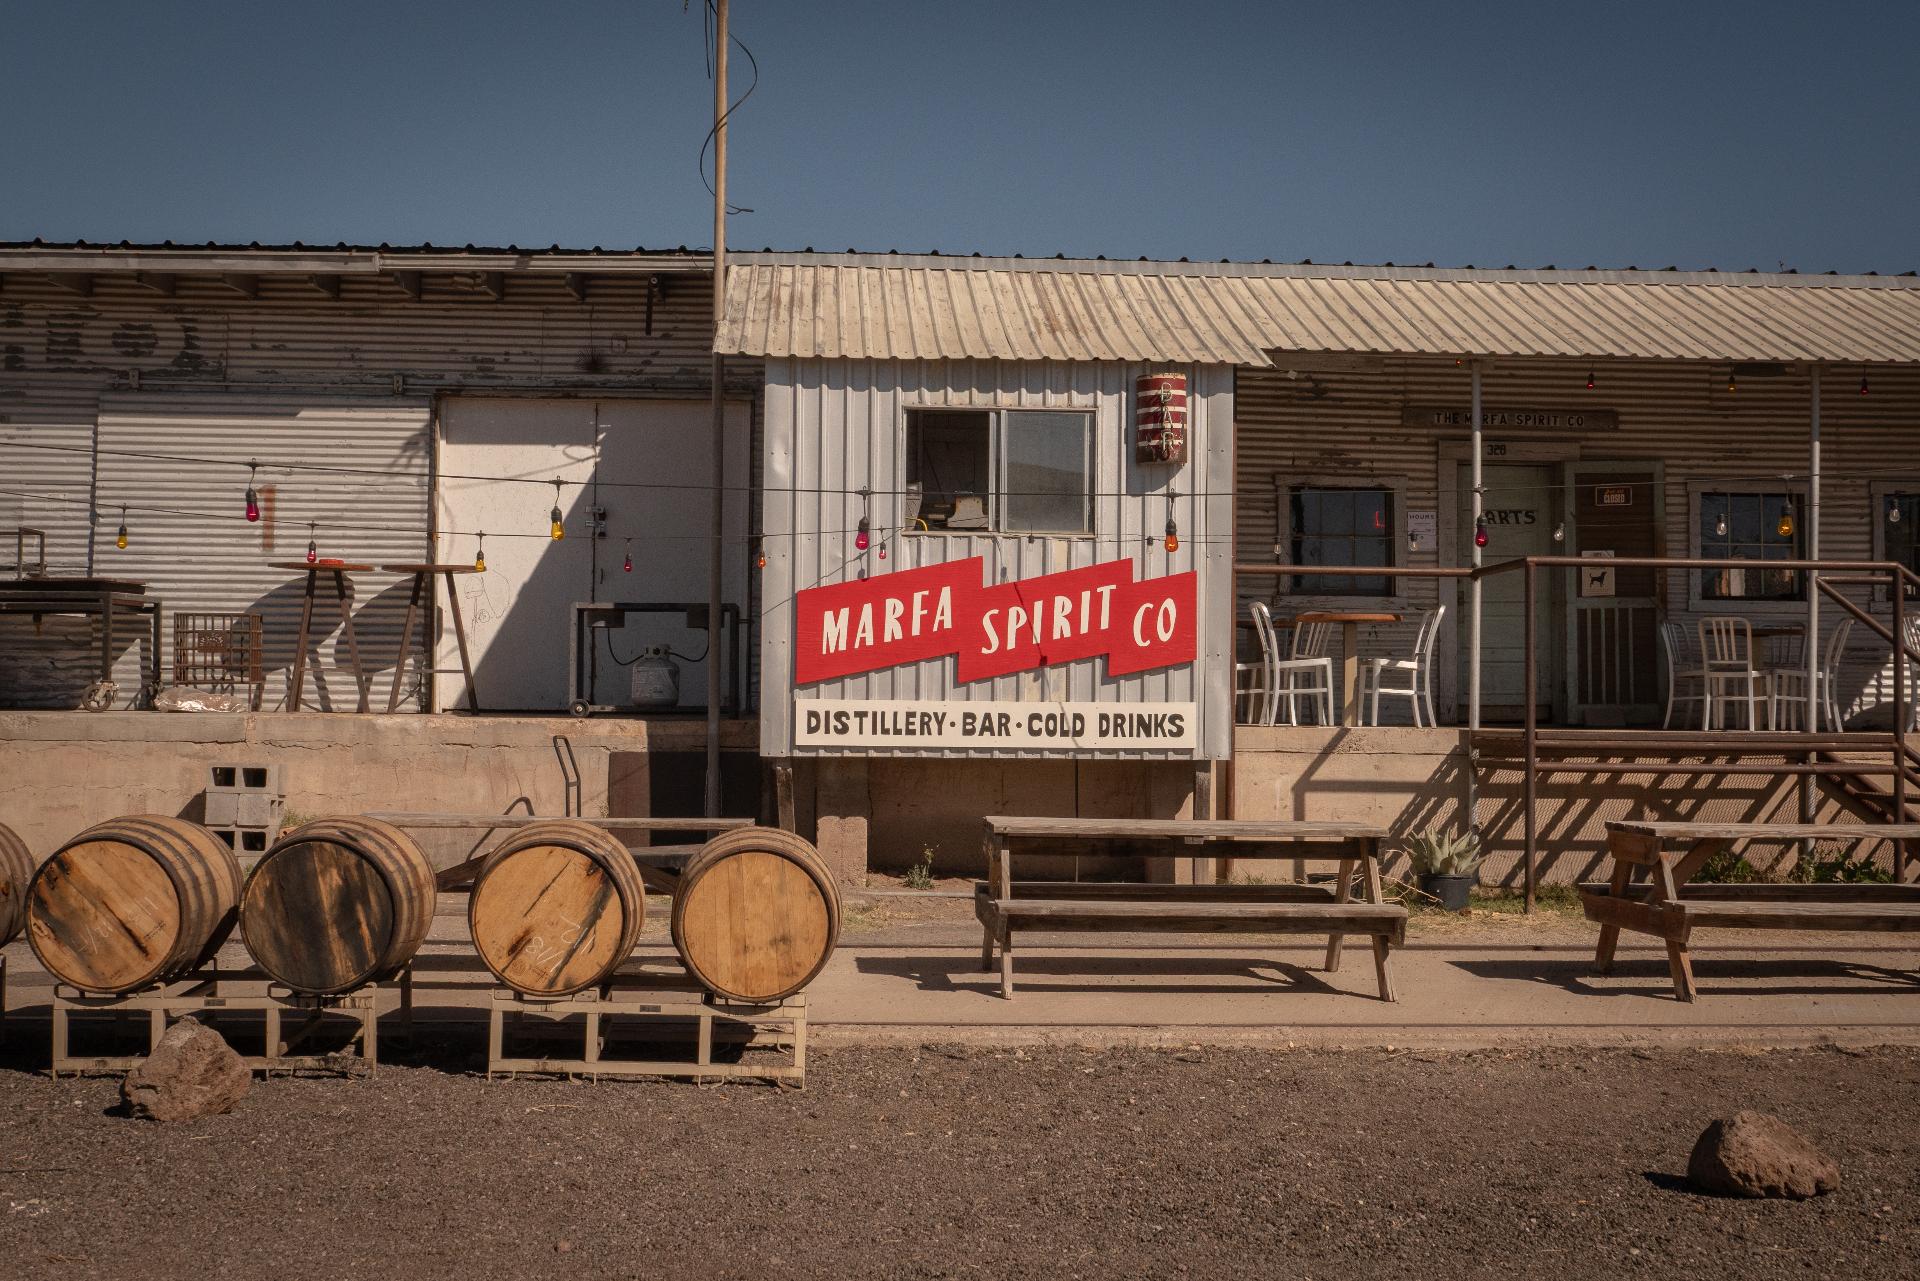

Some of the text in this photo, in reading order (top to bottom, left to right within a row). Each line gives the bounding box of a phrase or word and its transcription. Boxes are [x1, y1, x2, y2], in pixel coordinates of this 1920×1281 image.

[1160, 381, 1175, 452] BAR
[1435, 412, 1584, 426] THE MRFA SPIRIT CO
[1487, 444, 1506, 456] 328
[1603, 494, 1625, 504] CLOSED
[1484, 510, 1536, 524] ARTS
[822, 584, 1177, 655] MARFA SPIRIT CO
[806, 710, 1185, 738] DISTILLERY BAR COLD DRINKS
